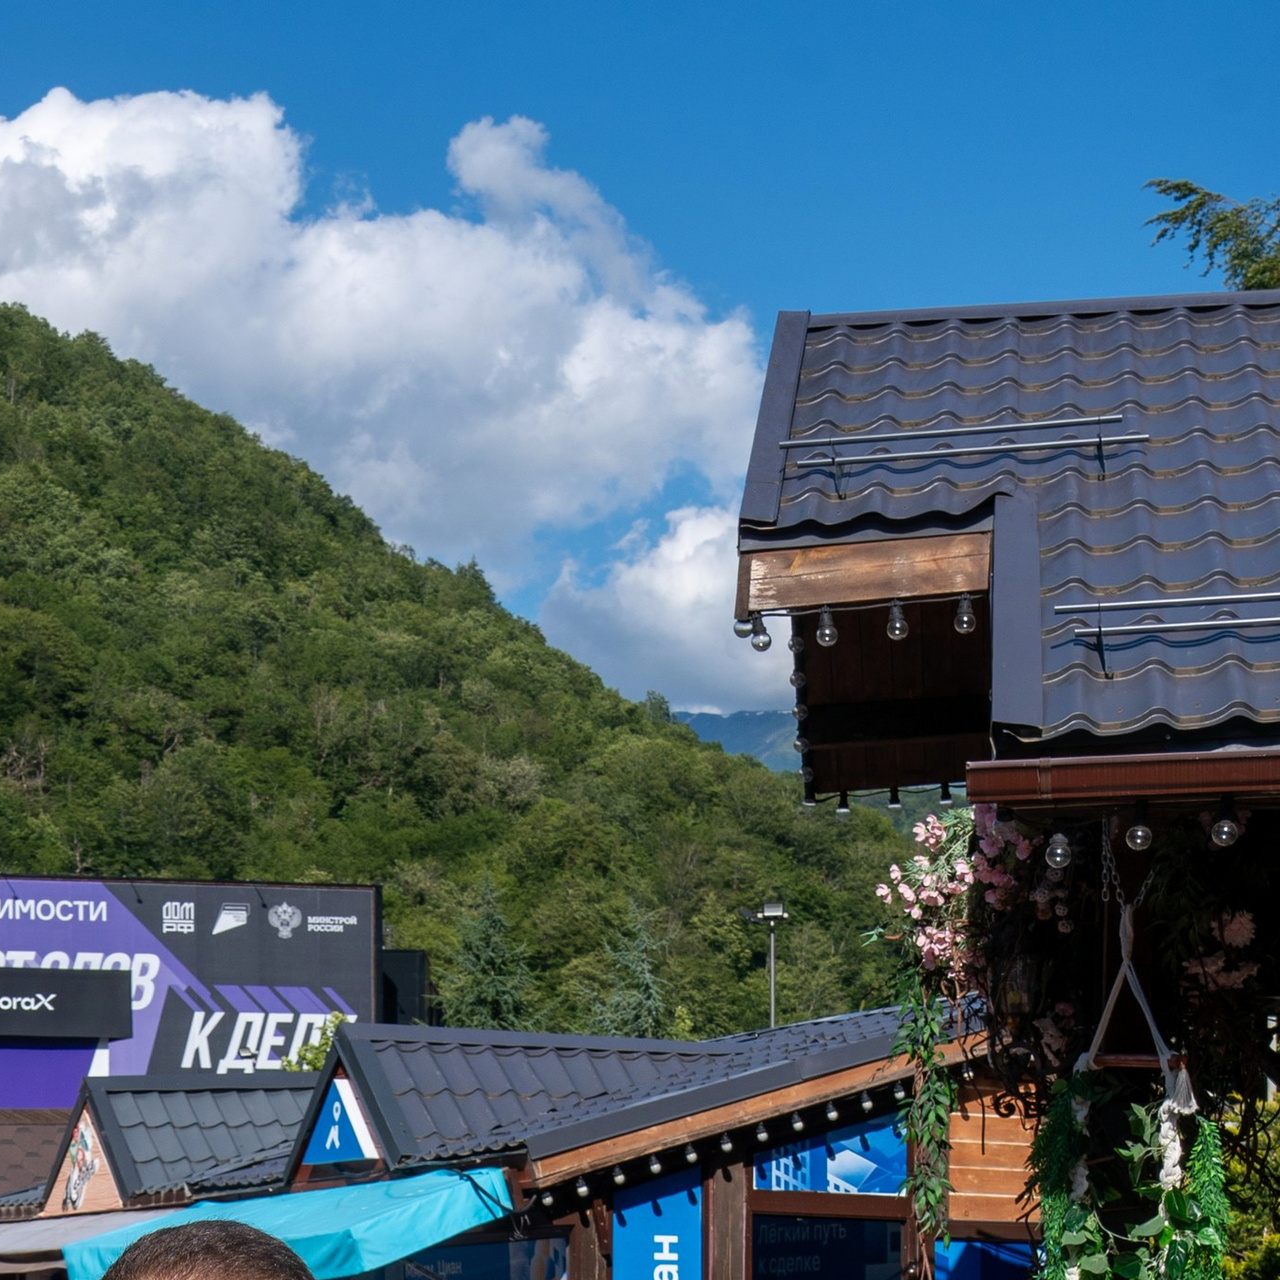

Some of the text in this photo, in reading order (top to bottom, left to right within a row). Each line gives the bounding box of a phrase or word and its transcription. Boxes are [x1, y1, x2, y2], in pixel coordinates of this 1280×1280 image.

[307, 915, 358, 926] МИНСТРОЙ
[307, 924, 344, 933] РОССИИ
[180, 1010, 226, 1069] К
[758, 1220, 847, 1246] Лёгкий путь
[769, 1255, 821, 1277] сделке
